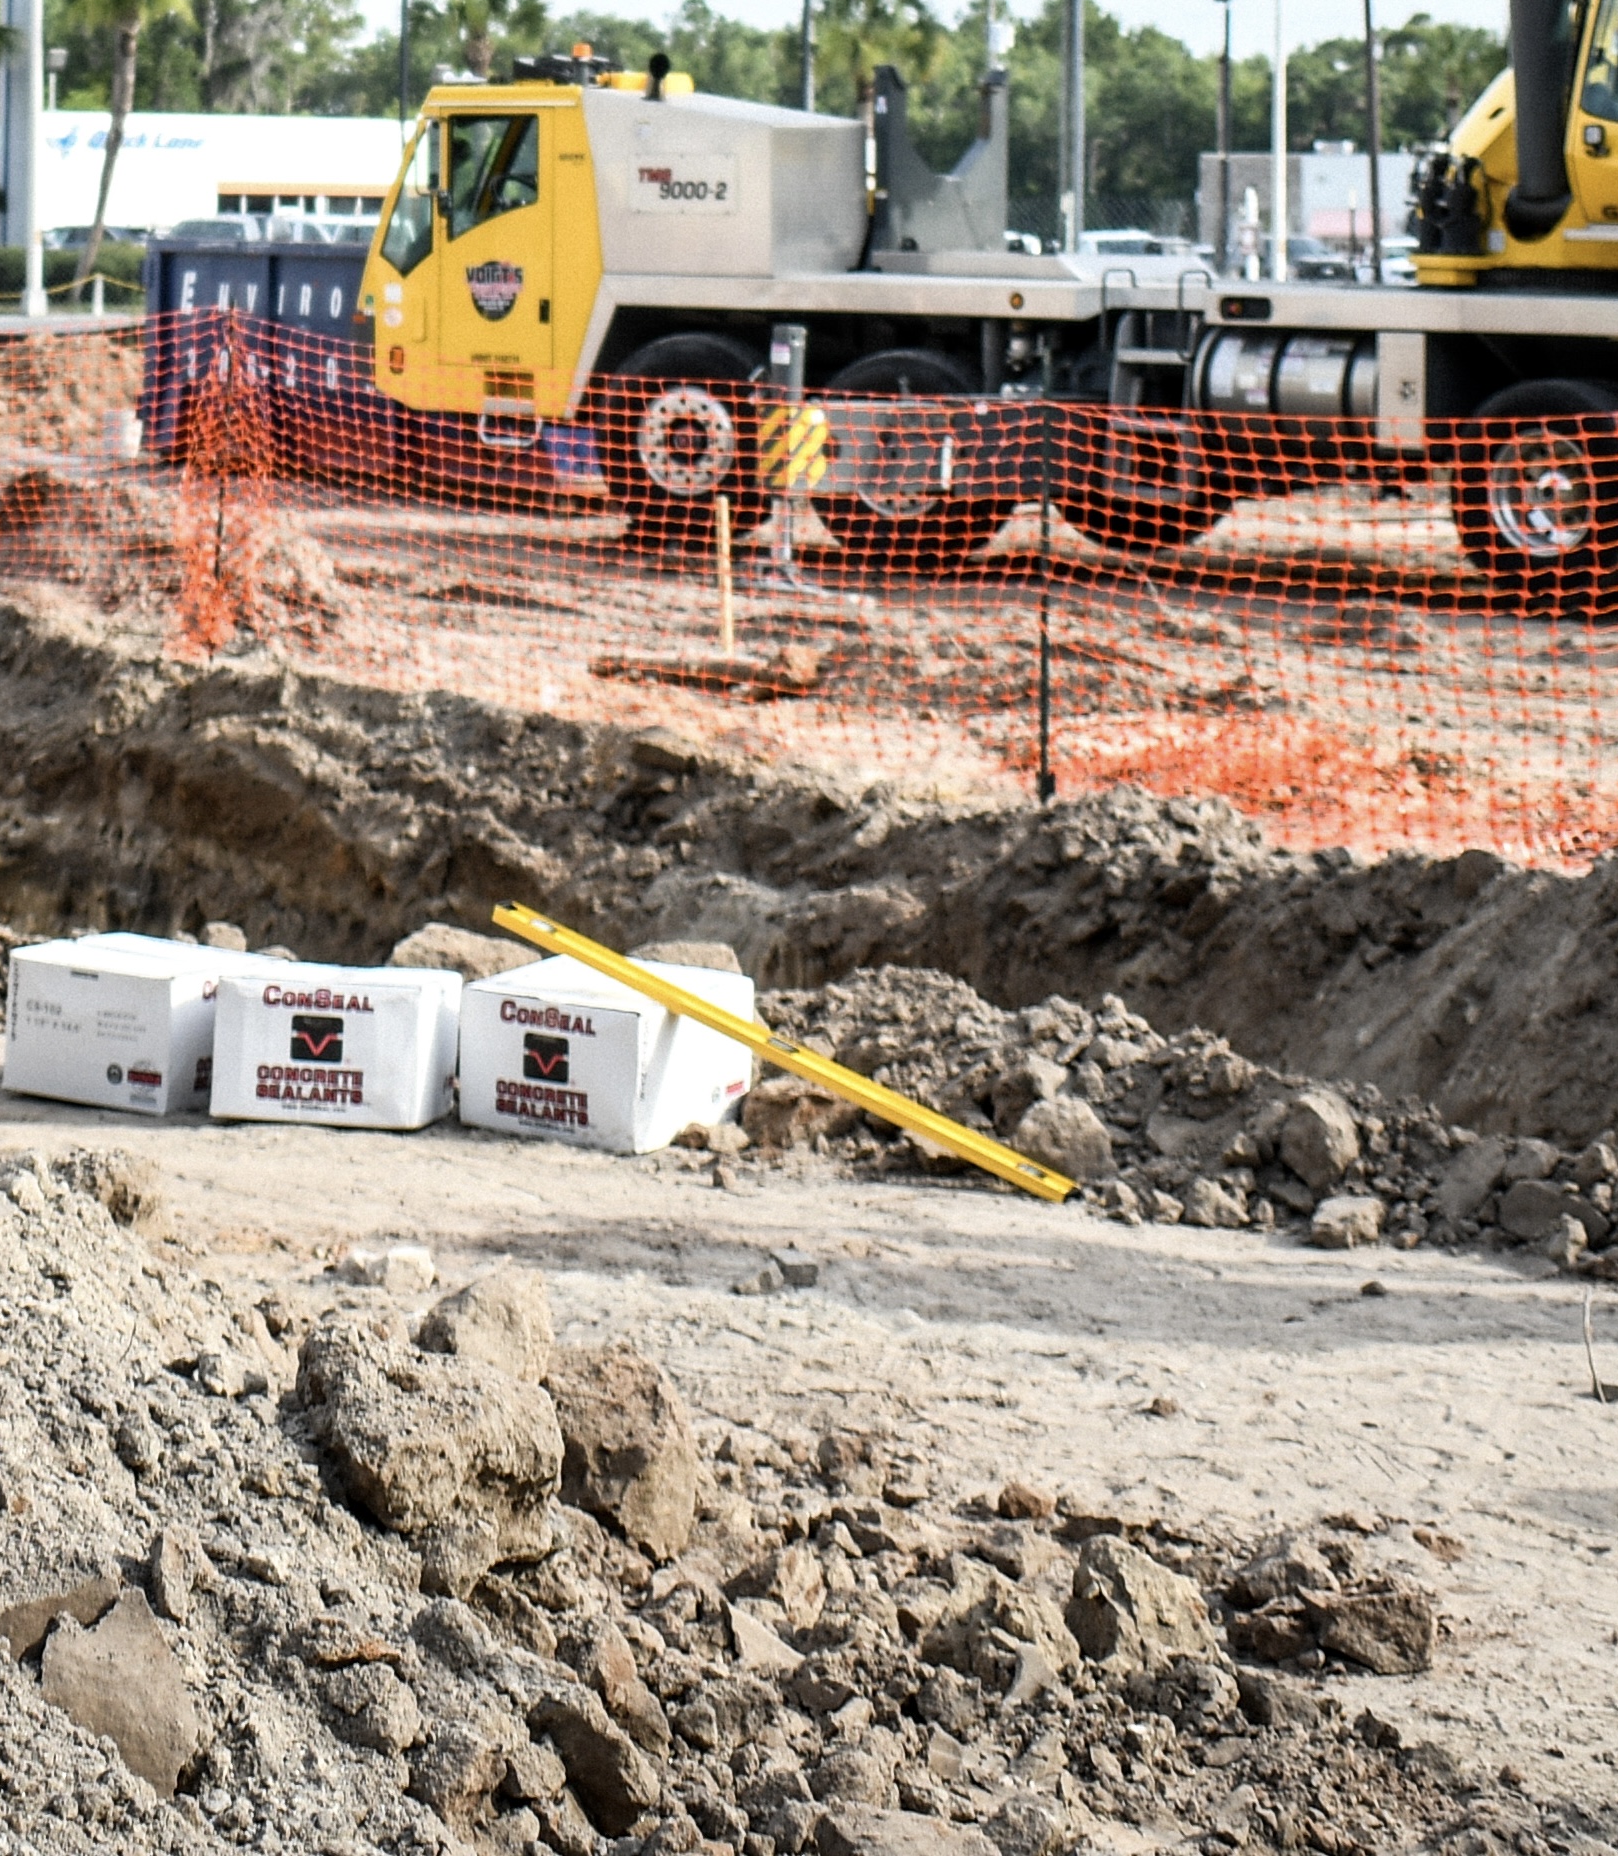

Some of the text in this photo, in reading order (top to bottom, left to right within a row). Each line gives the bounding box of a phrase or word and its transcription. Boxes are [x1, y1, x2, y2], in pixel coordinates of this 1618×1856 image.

[658, 181, 729, 201] 9000-2
[181, 270, 343, 320] ENVIRO
[256, 1064, 364, 1088] CONCRETE
[256, 1082, 364, 1105] SEALANTS
[495, 1079, 589, 1111] CONCRETE
[495, 1097, 590, 1126] SEALANTS
